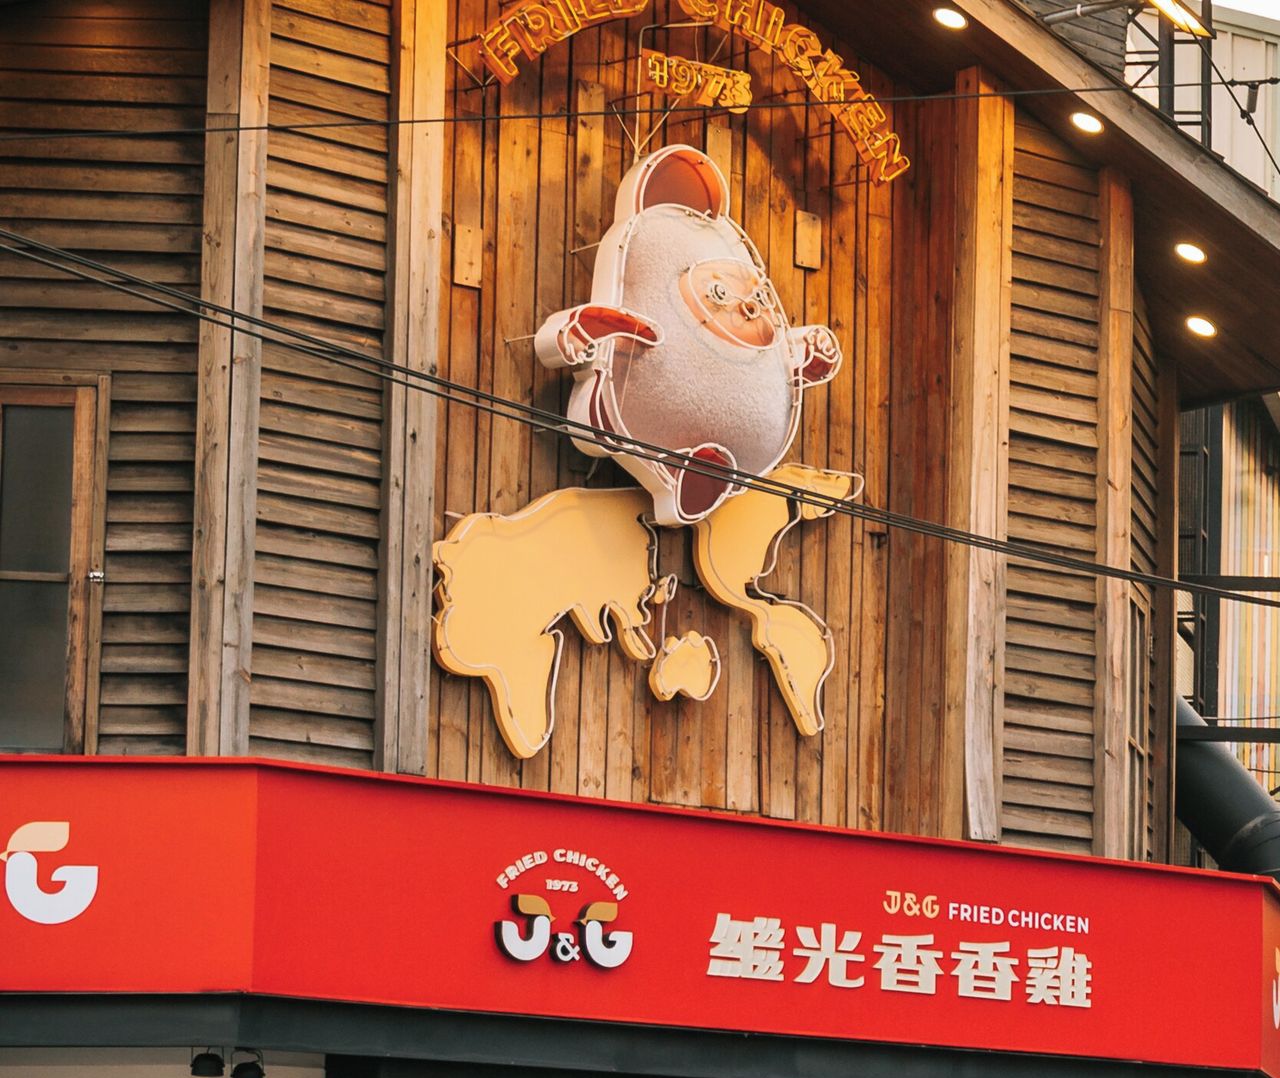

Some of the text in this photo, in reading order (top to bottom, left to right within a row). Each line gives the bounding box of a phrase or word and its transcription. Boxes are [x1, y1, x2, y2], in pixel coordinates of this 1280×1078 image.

[496, 848, 629, 901] FRIED CHICKEN
[545, 879, 579, 892] 1973
[500, 893, 634, 968] J&G
[883, 889, 1090, 935] J&G FRIED CHICKEN
[707, 913, 1094, 1010] 繼光香香雞
